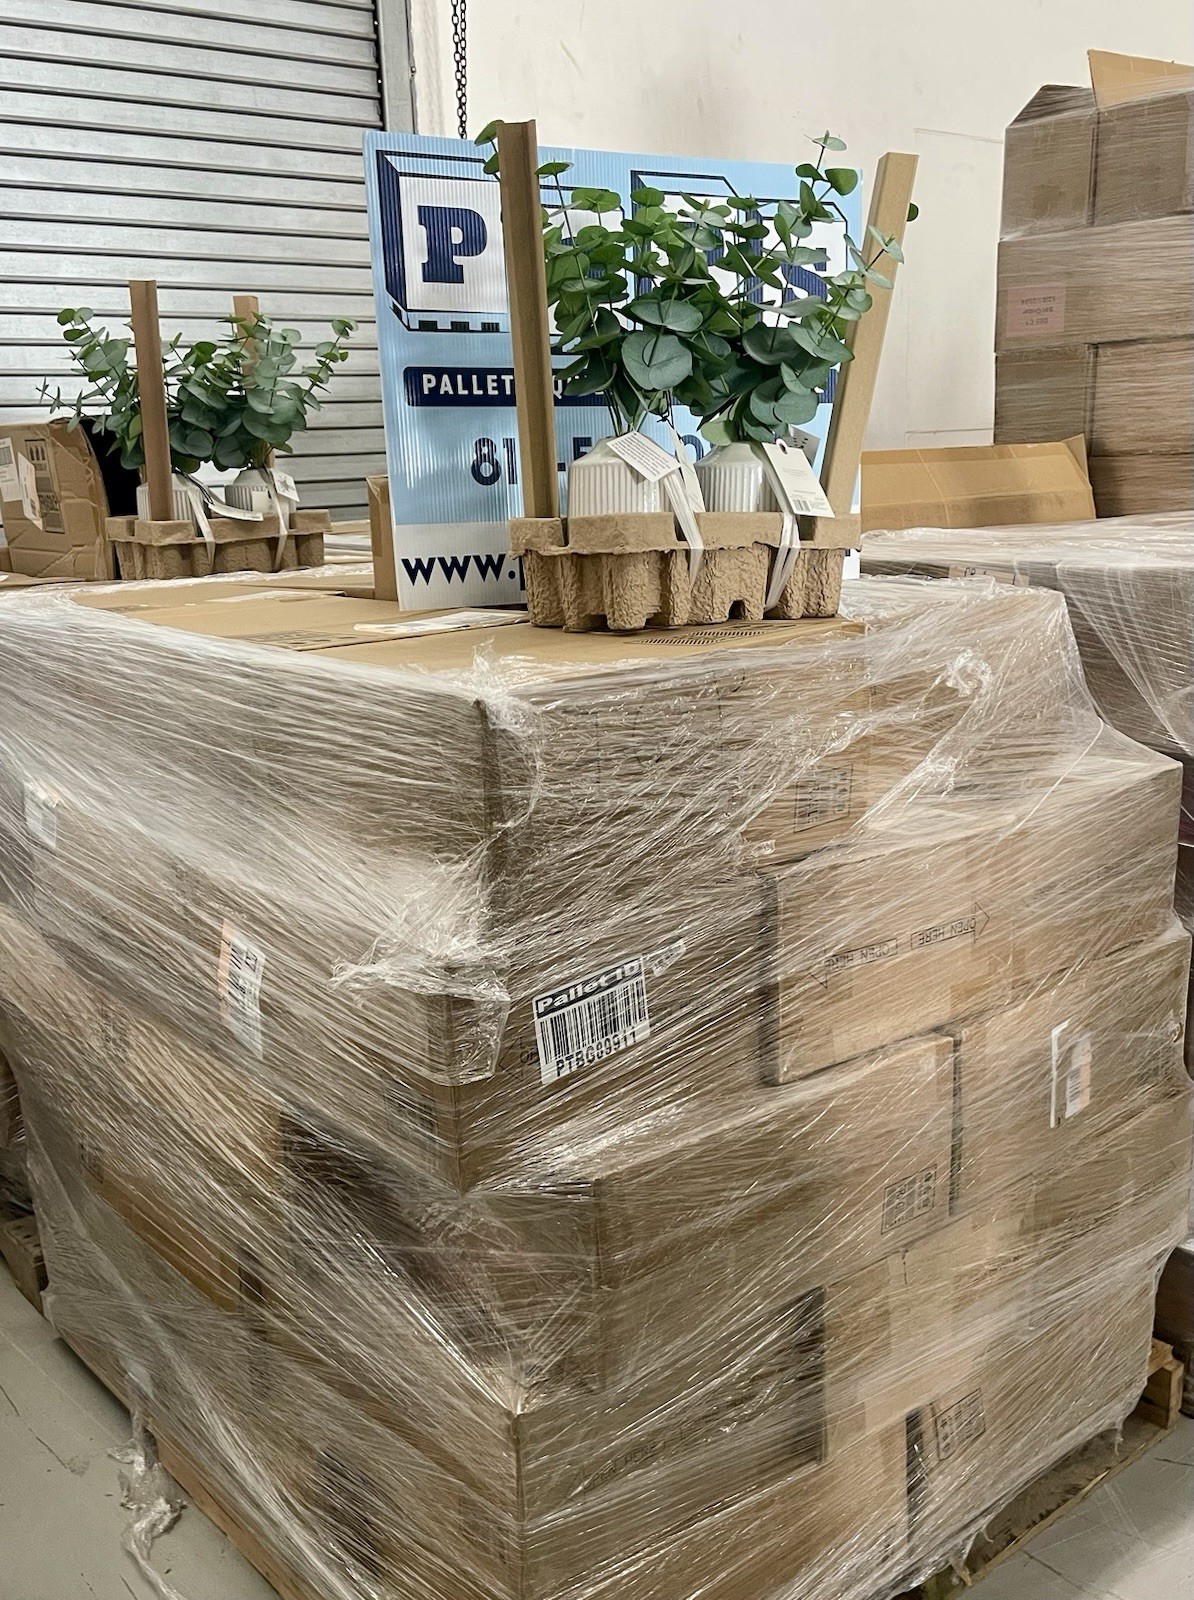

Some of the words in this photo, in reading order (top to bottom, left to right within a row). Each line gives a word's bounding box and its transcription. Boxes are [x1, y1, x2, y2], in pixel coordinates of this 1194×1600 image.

[422, 373, 515, 395] PALLET
[918, 926, 946, 946] HERE
[950, 917, 977, 938] OPEN
